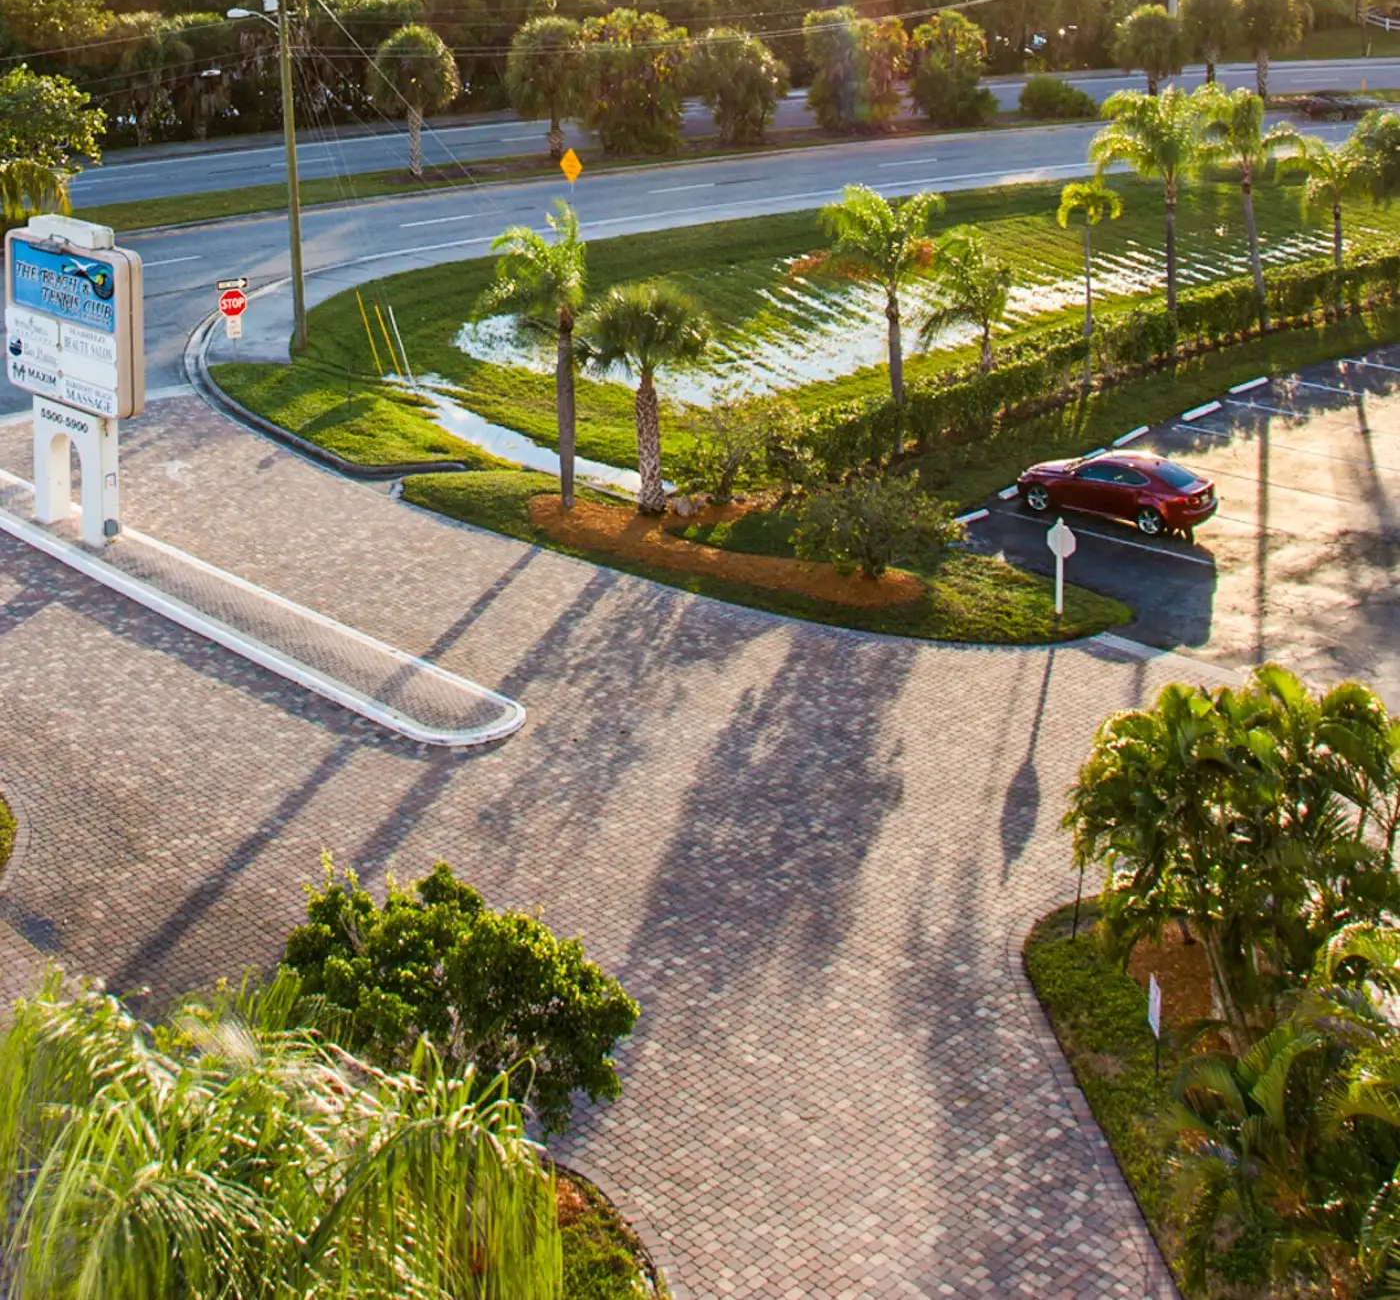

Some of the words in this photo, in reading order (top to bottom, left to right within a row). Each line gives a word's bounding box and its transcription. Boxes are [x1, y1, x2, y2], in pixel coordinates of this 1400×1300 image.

[16, 261, 38, 281] THE
[41, 269, 79, 294] BEACH
[82, 282, 92, 297] &
[42, 286, 79, 310] TENNIS
[83, 300, 112, 321] CLUB
[221, 297, 245, 310] STOP
[27, 367, 57, 387] MAXIM
[65, 388, 113, 414] MASSAGE
